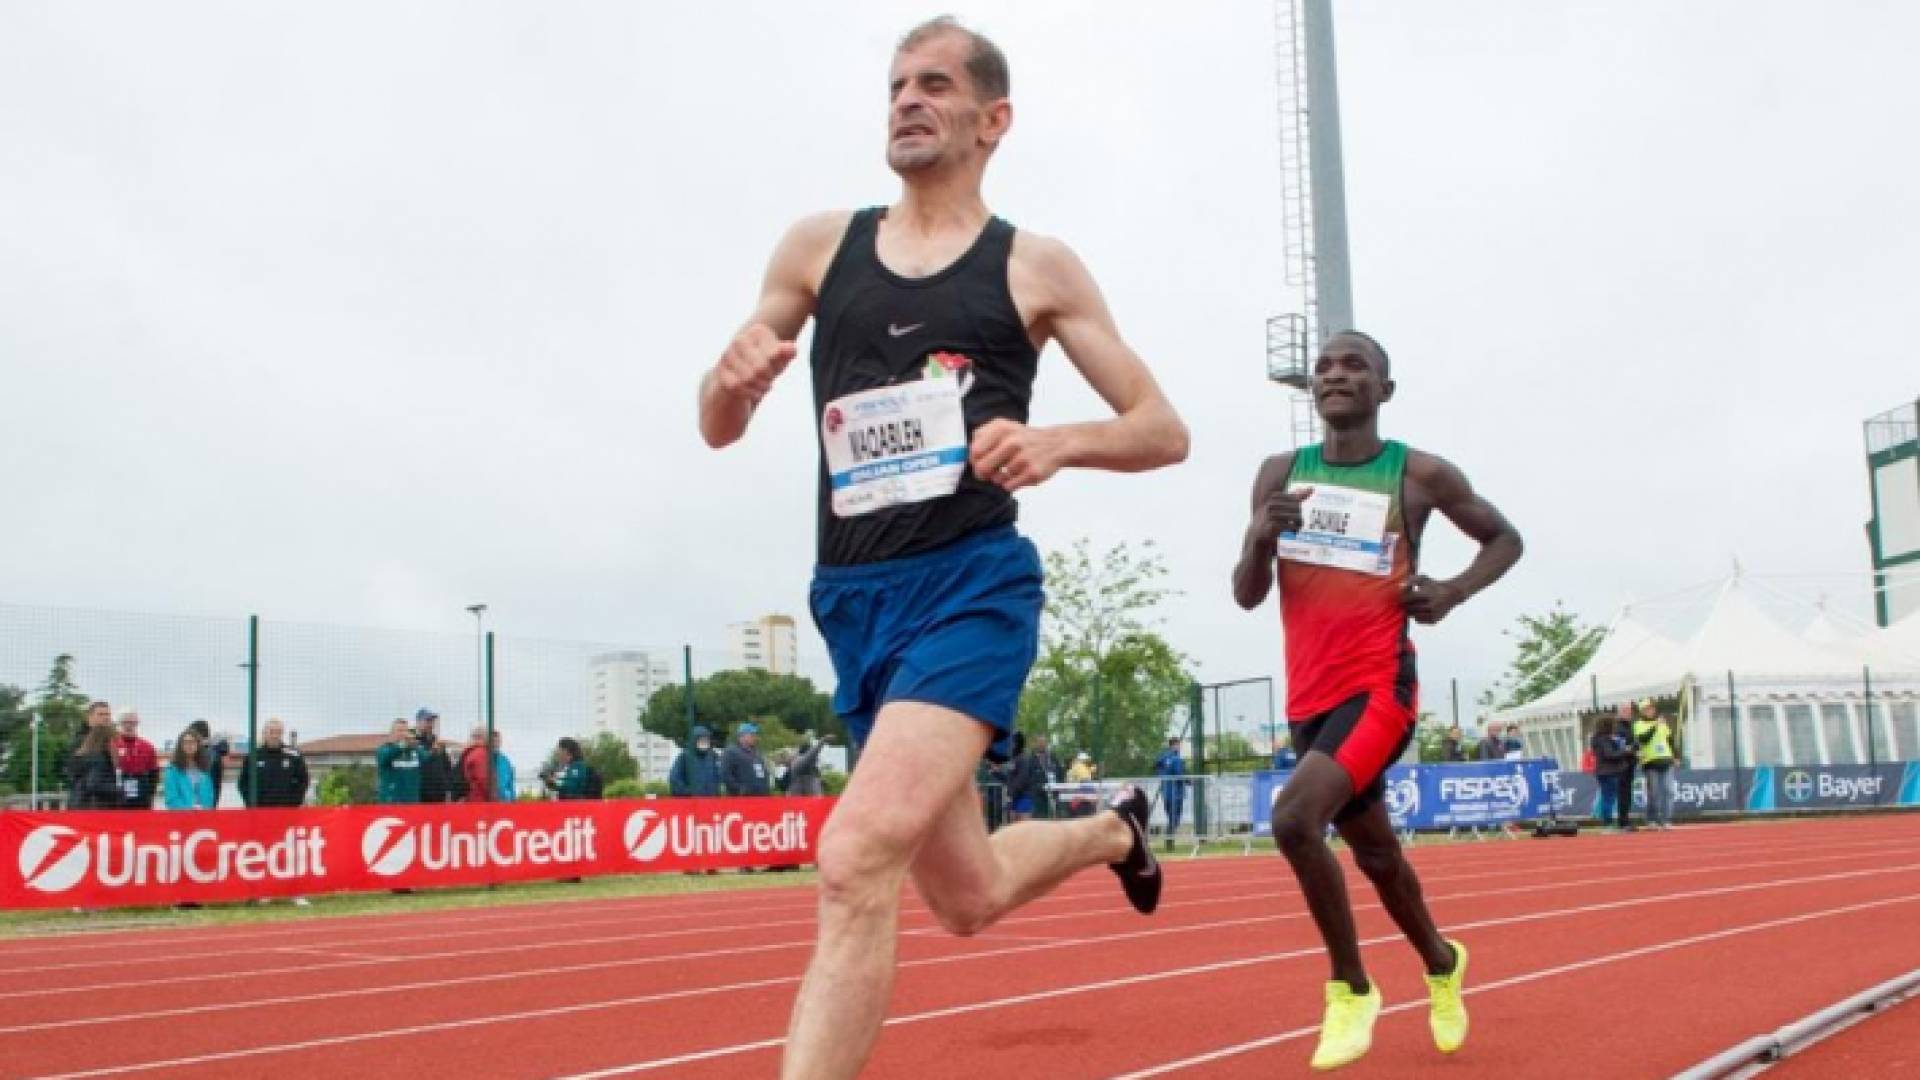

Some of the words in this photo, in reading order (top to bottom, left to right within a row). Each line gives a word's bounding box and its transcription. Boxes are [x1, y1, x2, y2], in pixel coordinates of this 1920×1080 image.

[1818, 774, 1883, 801] Bayer
[97, 826, 327, 887] UniCredit
[421, 816, 597, 870] UniCredit
[672, 810, 807, 856] UniCredit
